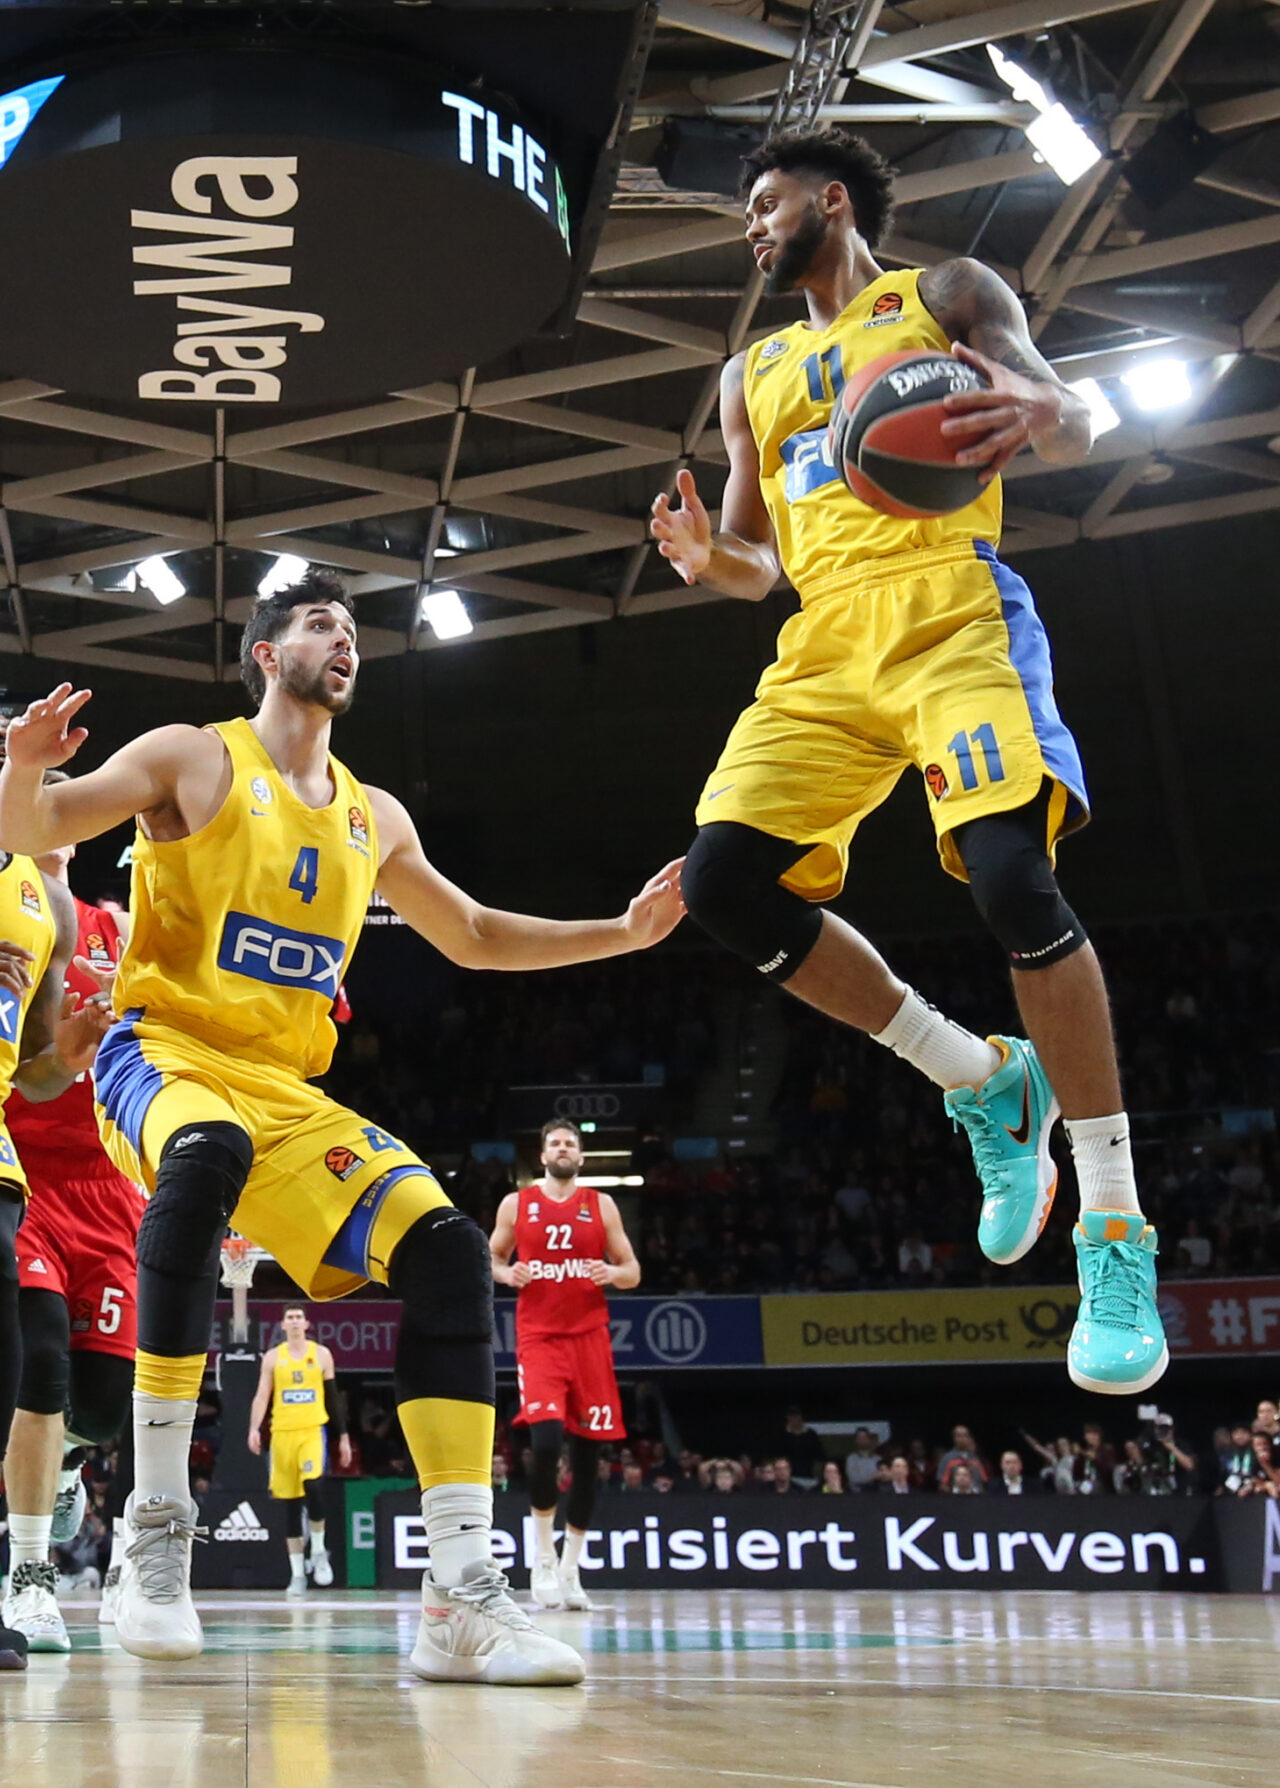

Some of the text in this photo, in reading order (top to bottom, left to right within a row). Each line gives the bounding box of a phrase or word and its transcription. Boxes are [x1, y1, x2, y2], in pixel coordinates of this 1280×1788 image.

[441, 90, 549, 213] THE
[131, 155, 325, 402] BayWa
[800, 344, 846, 402] 11
[947, 723, 1005, 791] 11
[288, 846, 319, 904] 4
[232, 926, 344, 989] FOX
[545, 1224, 573, 1250] 22
[97, 1286, 125, 1335] 5
[802, 1317, 1011, 1346] Deutsche Post
[284, 1390, 315, 1402] FOX
[587, 1405, 614, 1431] 22
[214, 1528, 269, 1541] adidas
[393, 1515, 859, 1571] Eektrisiert
[884, 1516, 1207, 1573] Kurven.
